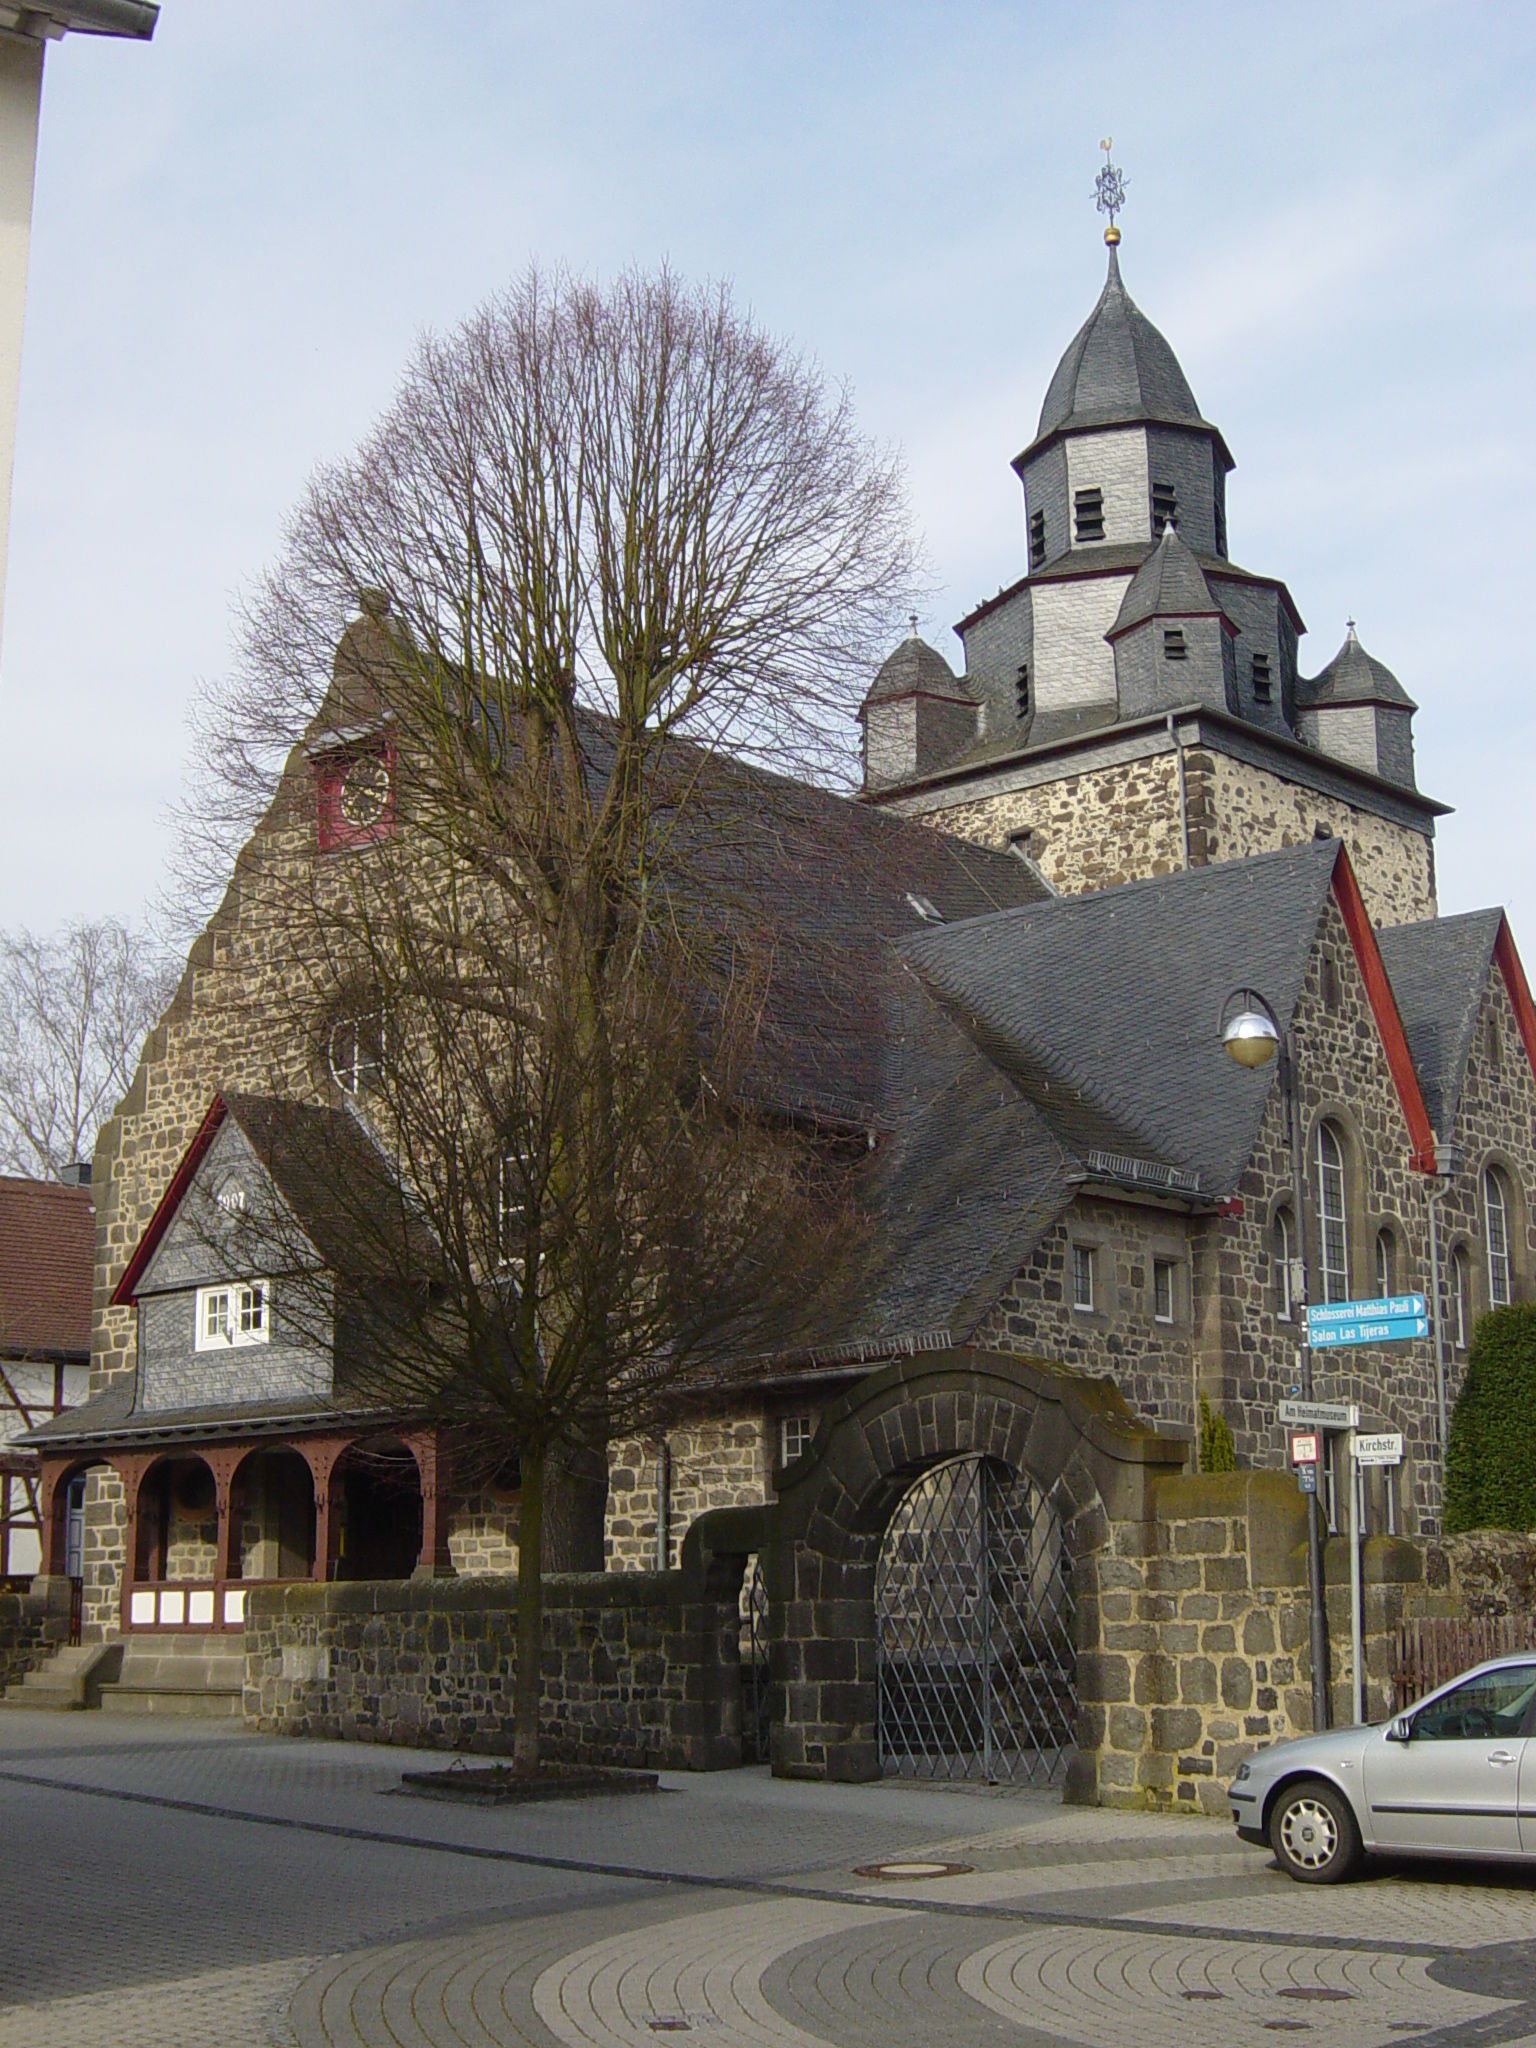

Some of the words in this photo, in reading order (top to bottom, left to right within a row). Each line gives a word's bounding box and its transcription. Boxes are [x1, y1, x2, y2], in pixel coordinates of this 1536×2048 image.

[1312, 1328, 1336, 1343] Salon
[1340, 1327, 1356, 1340] Las
[1359, 1324, 1389, 1340] Tijeras
[1285, 1403, 1296, 1416] Am
[1359, 1437, 1398, 1451] Kirchstr.
